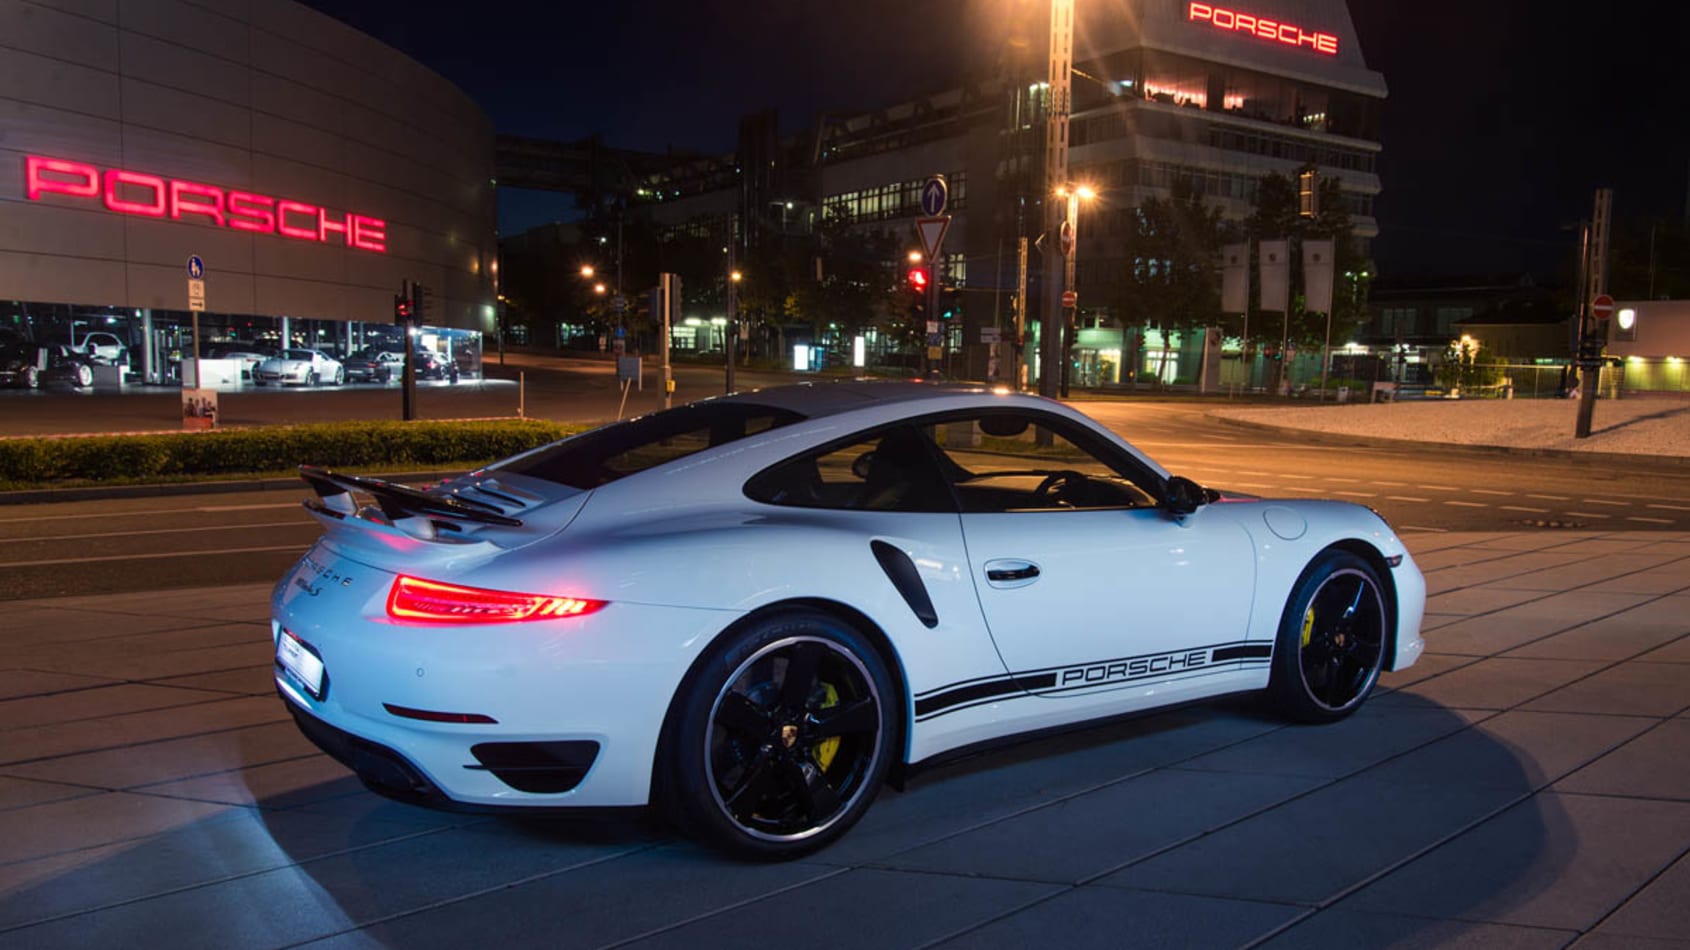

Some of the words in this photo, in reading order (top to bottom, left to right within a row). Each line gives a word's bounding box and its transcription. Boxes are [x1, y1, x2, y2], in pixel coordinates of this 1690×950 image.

[1189, 2, 1338, 54] PORSCHE
[25, 155, 386, 252] PORSCHE
[302, 558, 353, 587] SCHE
[1061, 651, 1207, 686] PORSCHE
